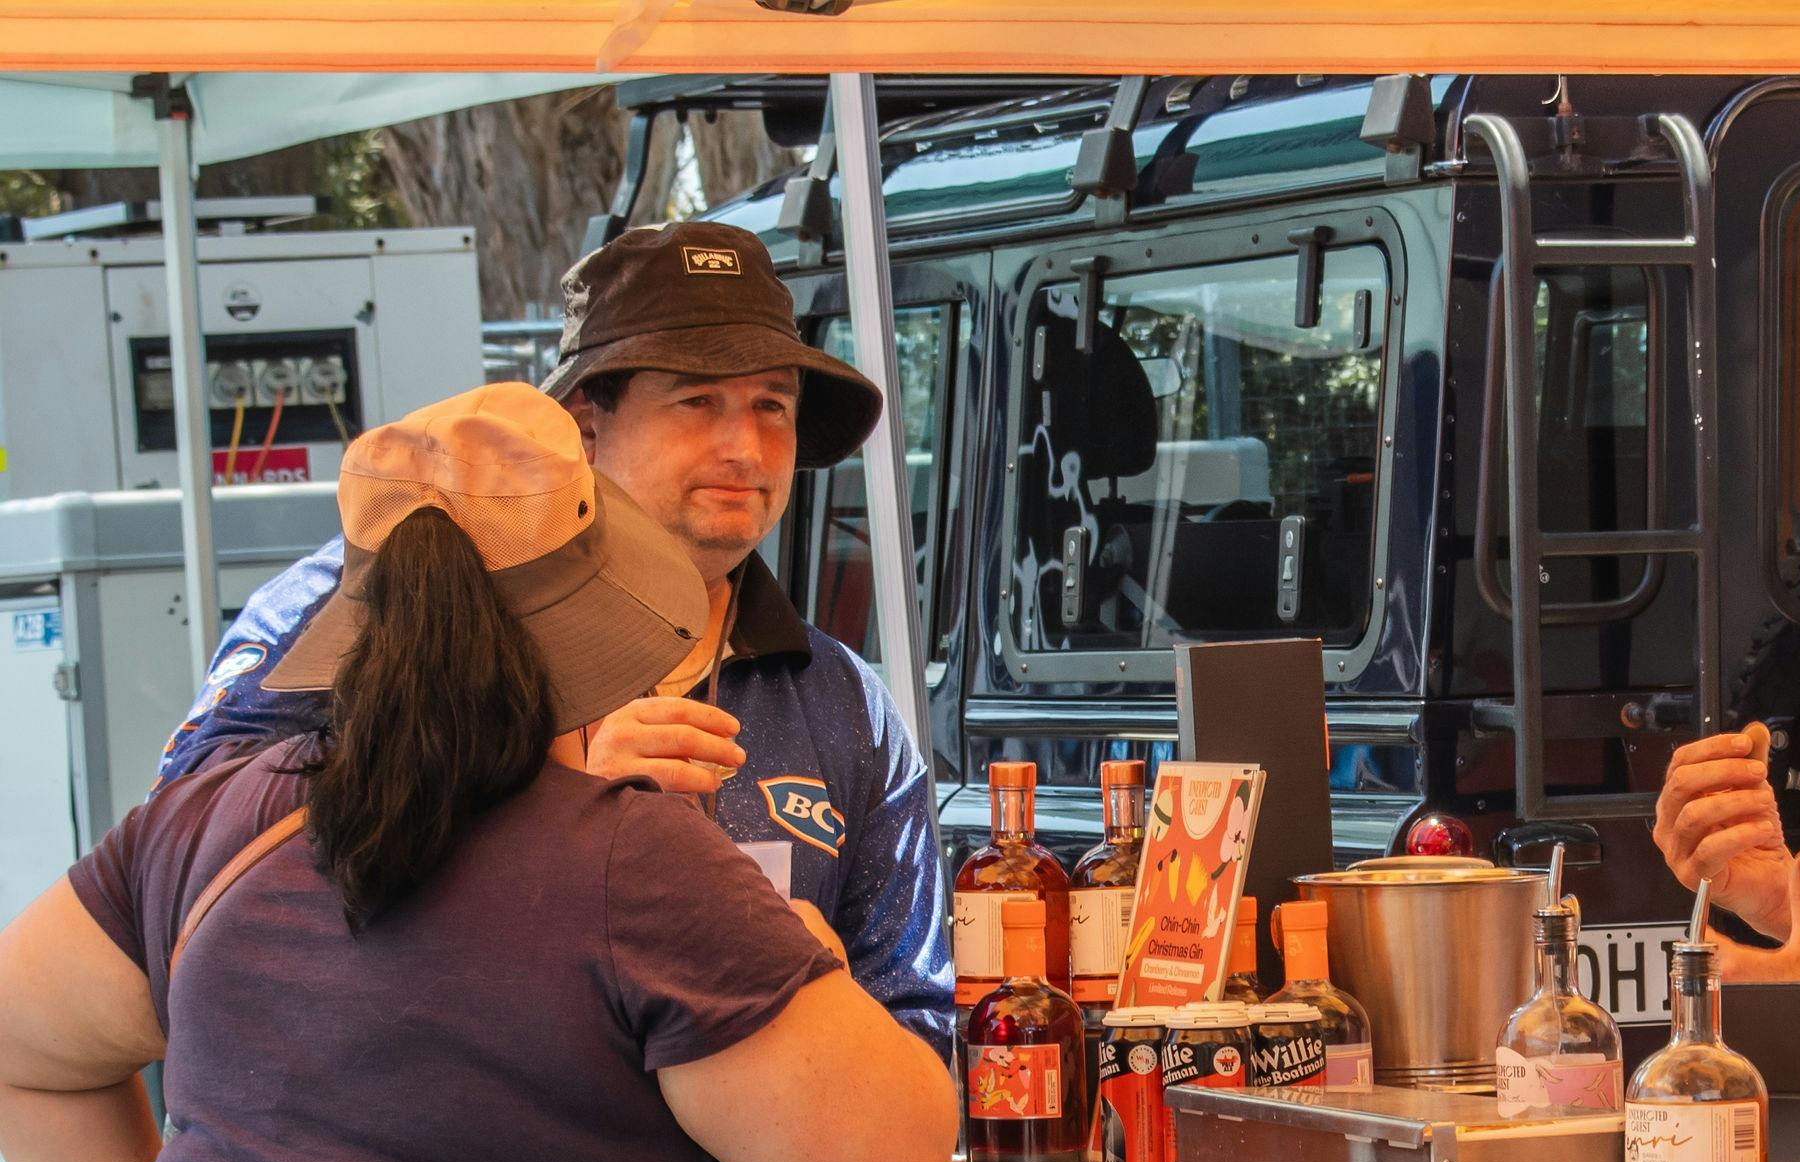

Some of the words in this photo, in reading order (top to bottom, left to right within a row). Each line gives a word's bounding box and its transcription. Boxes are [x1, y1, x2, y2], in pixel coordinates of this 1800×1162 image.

[1160, 916, 1200, 935] Chin-Chin
[1148, 939, 1188, 959] Christmas
[1189, 943, 1204, 960] Gin
[1250, 1037, 1323, 1073] Willie
[1271, 1057, 1325, 1085] Boatman
